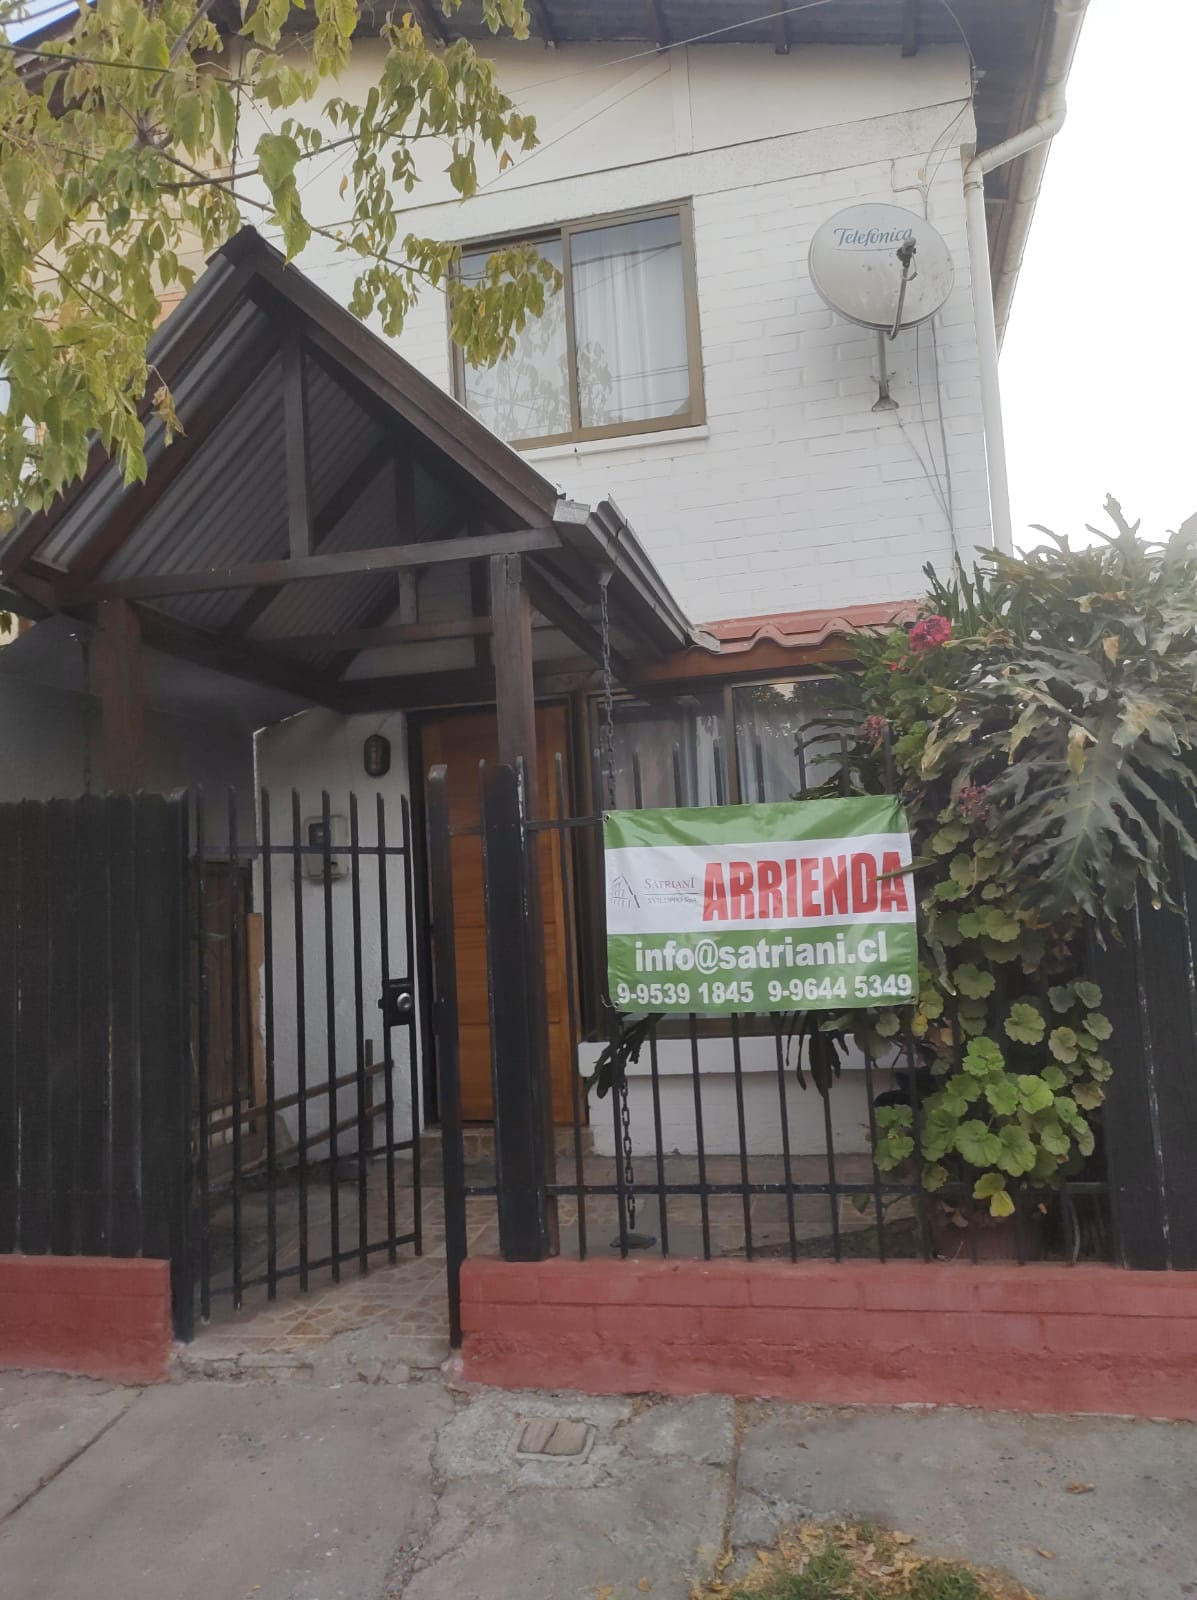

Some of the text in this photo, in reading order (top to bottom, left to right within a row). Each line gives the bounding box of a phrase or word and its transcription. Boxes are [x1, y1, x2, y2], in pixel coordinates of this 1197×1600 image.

[702, 852, 908, 921] ARRIENDA
[635, 931, 888, 974] info@satriani.cl
[617, 974, 912, 1005] 9-9539 1845 9-9644 5349
